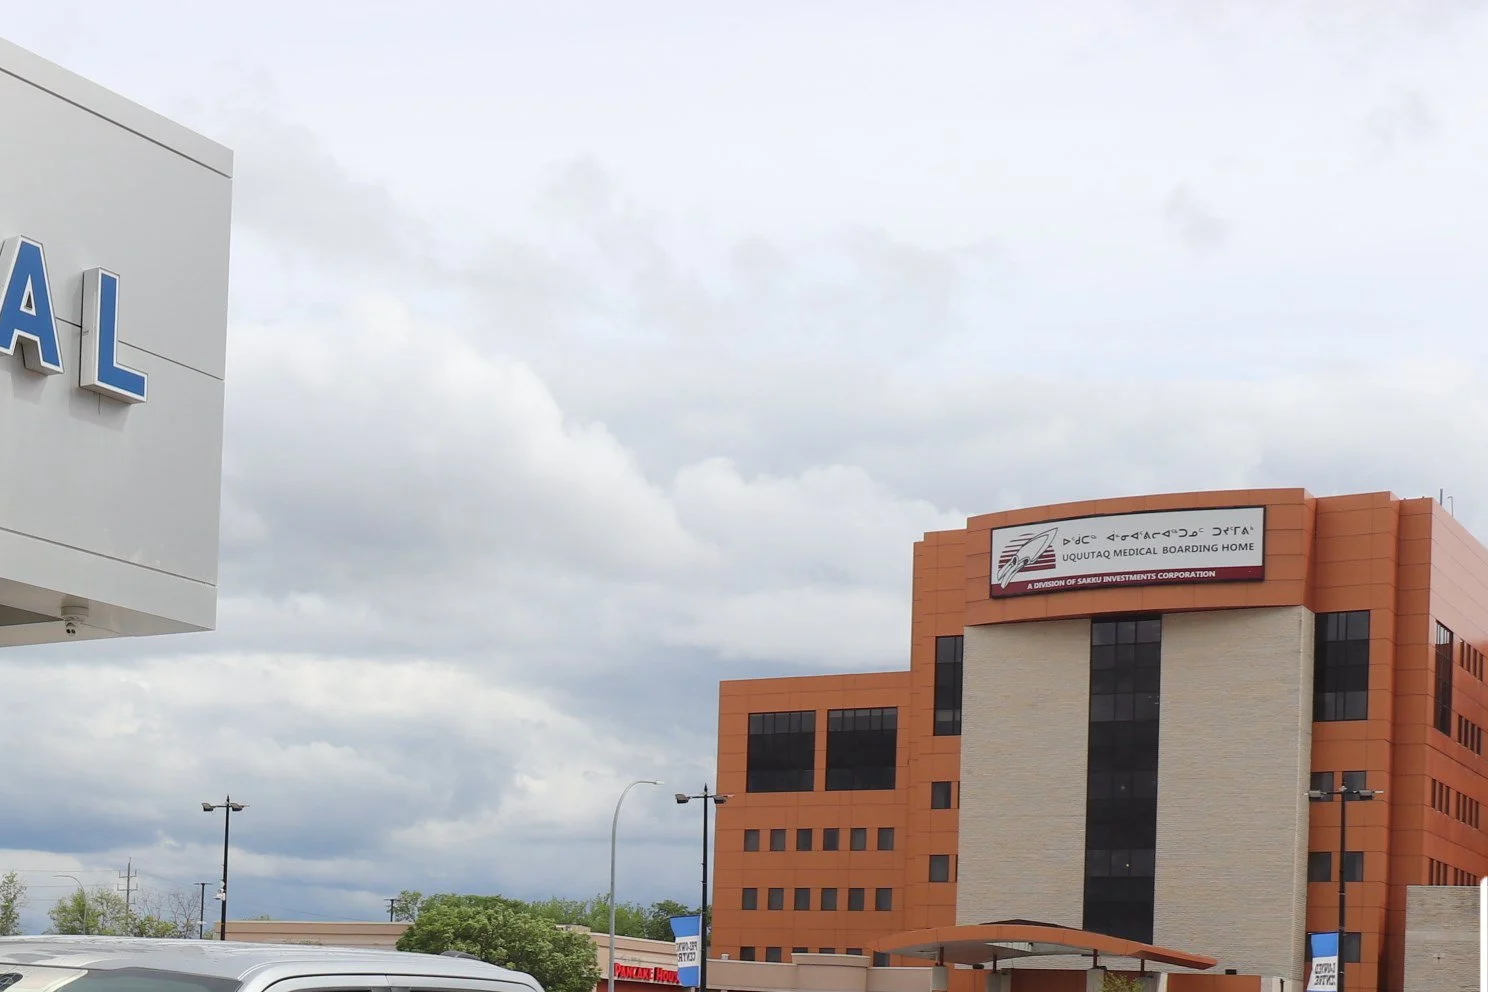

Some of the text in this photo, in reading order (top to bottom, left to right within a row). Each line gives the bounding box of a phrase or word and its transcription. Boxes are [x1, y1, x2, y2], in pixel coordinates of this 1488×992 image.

[1062, 543, 1255, 562] UQUUTAQ MEDICAL BOARDING HOME
[1033, 580, 1065, 589] DIVISION
[1066, 578, 1077, 586] OF
[1077, 576, 1102, 585] SAKKU
[1103, 572, 1157, 583] INVESTMENTS
[1157, 570, 1216, 580] CORPORATION
[614, 963, 680, 983] PANCAKE HOUS
